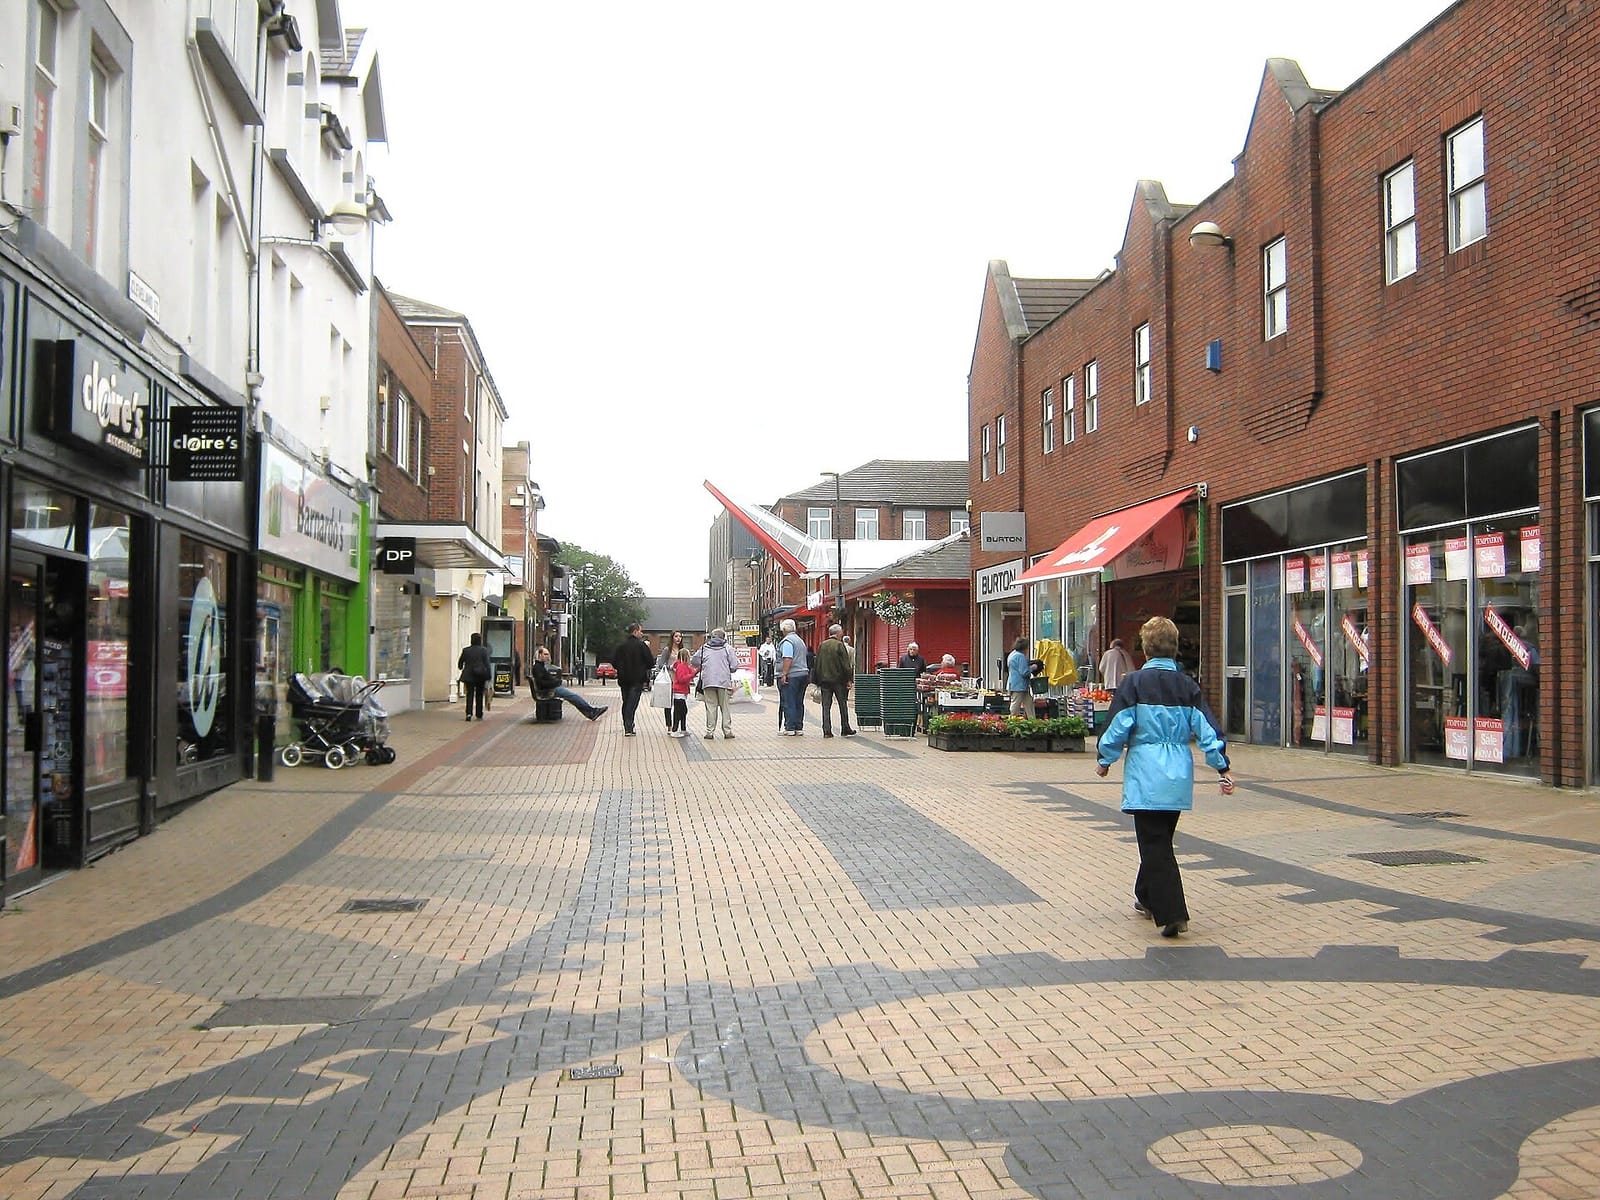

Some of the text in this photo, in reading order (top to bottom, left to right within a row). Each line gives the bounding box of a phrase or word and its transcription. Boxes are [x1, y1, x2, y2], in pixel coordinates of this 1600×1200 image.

[298, 488, 344, 552] Barnardo's
[387, 551, 413, 561] DP
[982, 568, 1016, 595] BURTON
[1488, 609, 1528, 665] STOCK CLEARANCE
[1480, 733, 1498, 746] Sale
